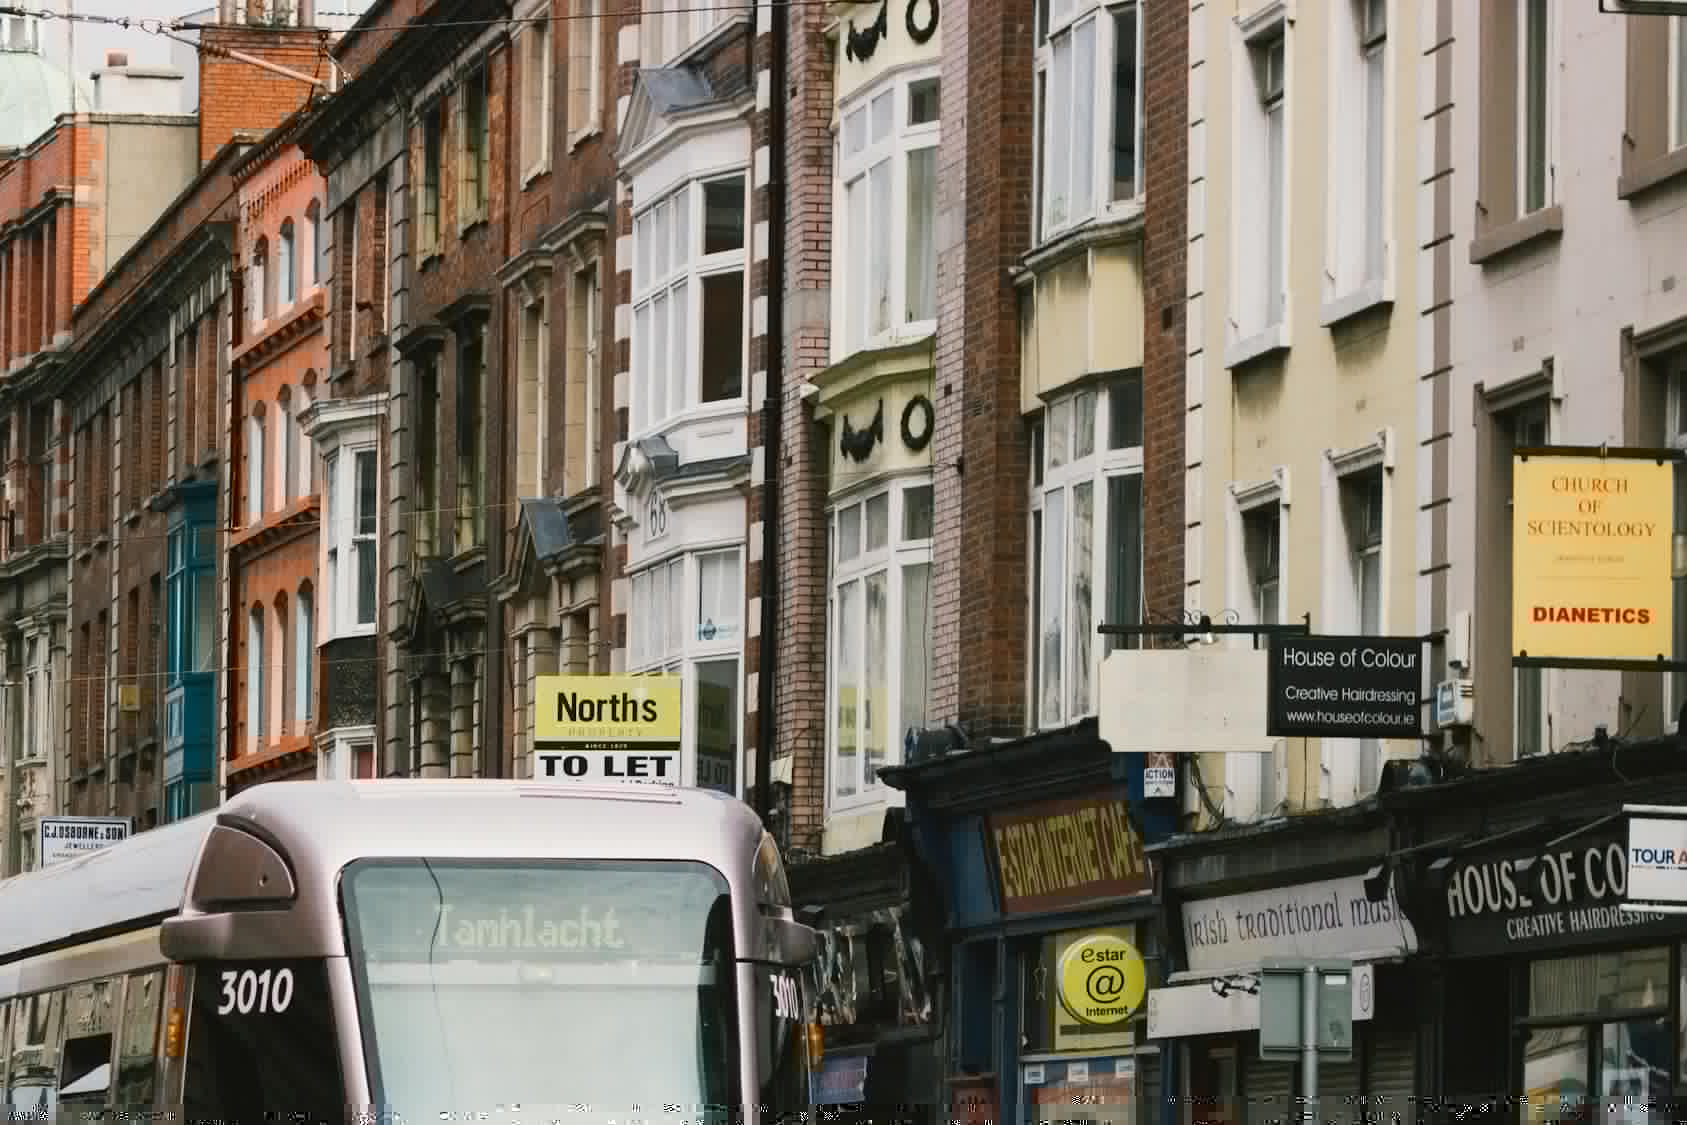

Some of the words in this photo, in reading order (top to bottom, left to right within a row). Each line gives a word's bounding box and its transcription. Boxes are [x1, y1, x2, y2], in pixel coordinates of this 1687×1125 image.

[1551, 474, 1628, 493] CHURCH
[1577, 498, 1601, 513] OF
[1527, 519, 1656, 537] SCIENTOLOGY
[1533, 606, 1650, 624] DIANETICS
[1283, 647, 1335, 667] House
[1340, 648, 1356, 667] of
[1362, 648, 1417, 669] Colour
[1285, 685, 1338, 700] Creative
[1342, 687, 1416, 705] Hairdressing
[557, 691, 657, 722] Norths
[1287, 711, 1415, 725] www.houseofcolour.ie
[539, 755, 588, 777] TO
[604, 755, 673, 777] LET
[1540, 852, 1576, 902] OF
[435, 903, 624, 947] Tamhlacht
[1189, 909, 1228, 947] Irish
[1236, 892, 1343, 941] traditional
[1506, 912, 1564, 940] CREATIVE
[218, 968, 294, 1016] 3010
[769, 974, 799, 1020] 3010
